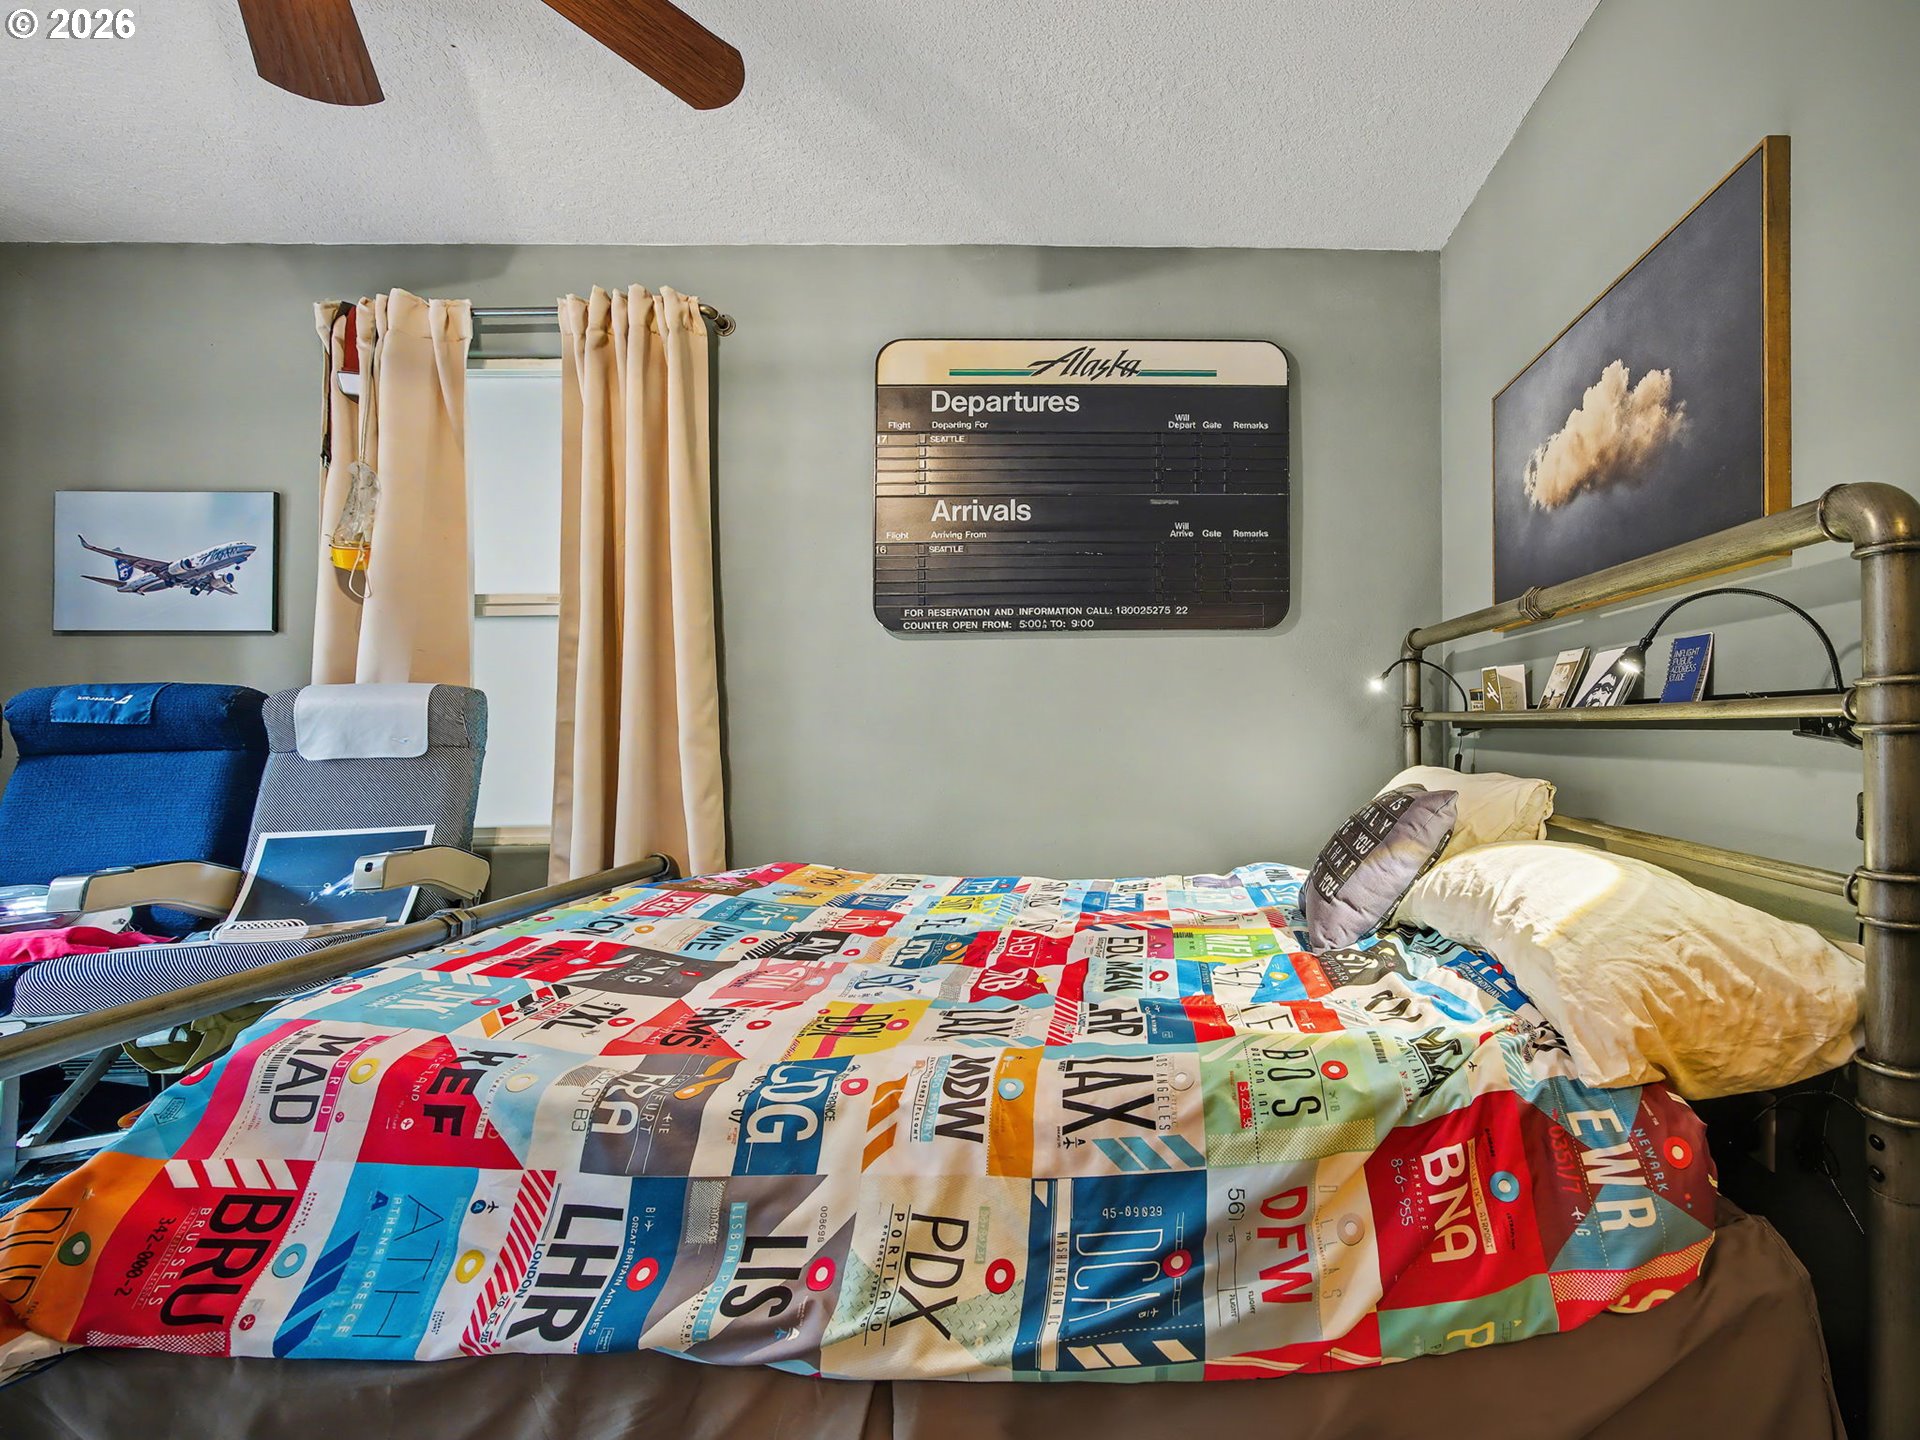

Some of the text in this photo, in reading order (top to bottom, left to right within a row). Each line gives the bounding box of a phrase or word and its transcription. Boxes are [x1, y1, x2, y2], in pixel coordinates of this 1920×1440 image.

[1027, 345, 1143, 381] Alaska
[931, 391, 1080, 416] Departures
[1174, 413, 1190, 421] Will
[888, 421, 988, 430] Flight Departing For
[930, 435, 965, 443] SEATTLE
[1168, 421, 1269, 430] Depart Gate Remarks
[931, 499, 1032, 522] Arrivals
[1174, 522, 1190, 530] Will
[886, 531, 987, 540] Flight Arriving From
[929, 545, 964, 553] SEATTLE
[1169, 529, 1269, 537] Arrive Gate Remarks
[903, 621, 949, 630] COUNTER
[952, 620, 978, 629] OPEN
[982, 620, 1012, 629] FROM:
[1050, 619, 1066, 628] TO:
[1071, 619, 1095, 628] 9:00
[904, 609, 924, 617] FOR
[928, 608, 990, 617] RESERVATION
[994, 608, 1014, 616] AND
[1019, 607, 1083, 616] INFORMATION
[1086, 606, 1113, 615] CALL:
[1327, 840, 1356, 875] THAT
[1352, 831, 1376, 854] YOU
[643, 894, 695, 914] PEK
[1318, 872, 1340, 897] YOU
[570, 914, 638, 936] ICN
[502, 947, 564, 971] NRT
[624, 959, 684, 984] PVG
[384, 985, 487, 1014] JFK
[541, 1003, 628, 1029] TXL
[660, 1007, 737, 1047] AMS
[806, 1014, 893, 1038] BCN
[935, 1005, 1020, 1039] LAX
[269, 1034, 365, 1125] MAD
[320, 1039, 378, 1115] MADRID
[423, 1050, 525, 1136] KEF
[1062, 1056, 1156, 1135] LAX
[1262, 1049, 1322, 1117] BOS
[590, 1073, 676, 1134] FRA
[825, 1091, 839, 1122] FRANCE
[935, 1054, 996, 1143] MDW
[1156, 1074, 1171, 1131] ANGELES
[1566, 1107, 1657, 1232] EWR
[1633, 1127, 1668, 1193] NEWARK
[1421, 1142, 1477, 1263] BNA
[375, 1197, 403, 1256] ATHENS
[725, 1205, 747, 1263] LISBON
[1256, 1185, 1313, 1304] DFW
[148, 1207, 212, 1307] BRUSSELS
[160, 1194, 295, 1327] BRU
[352, 1194, 444, 1338] ATH
[505, 1204, 624, 1342] LHR
[515, 1243, 545, 1299] LONDON
[614, 1247, 633, 1286] BRITAIN
[719, 1236, 808, 1318] LIS
[871, 1212, 905, 1332] PORTLAND
[889, 1213, 969, 1341] PDX
[1052, 1231, 1068, 1306] WASHINGTON
[1069, 1228, 1163, 1322] DCA
[337, 1270, 376, 1335] GREECE
[588, 1288, 616, 1336] AIRLINES
